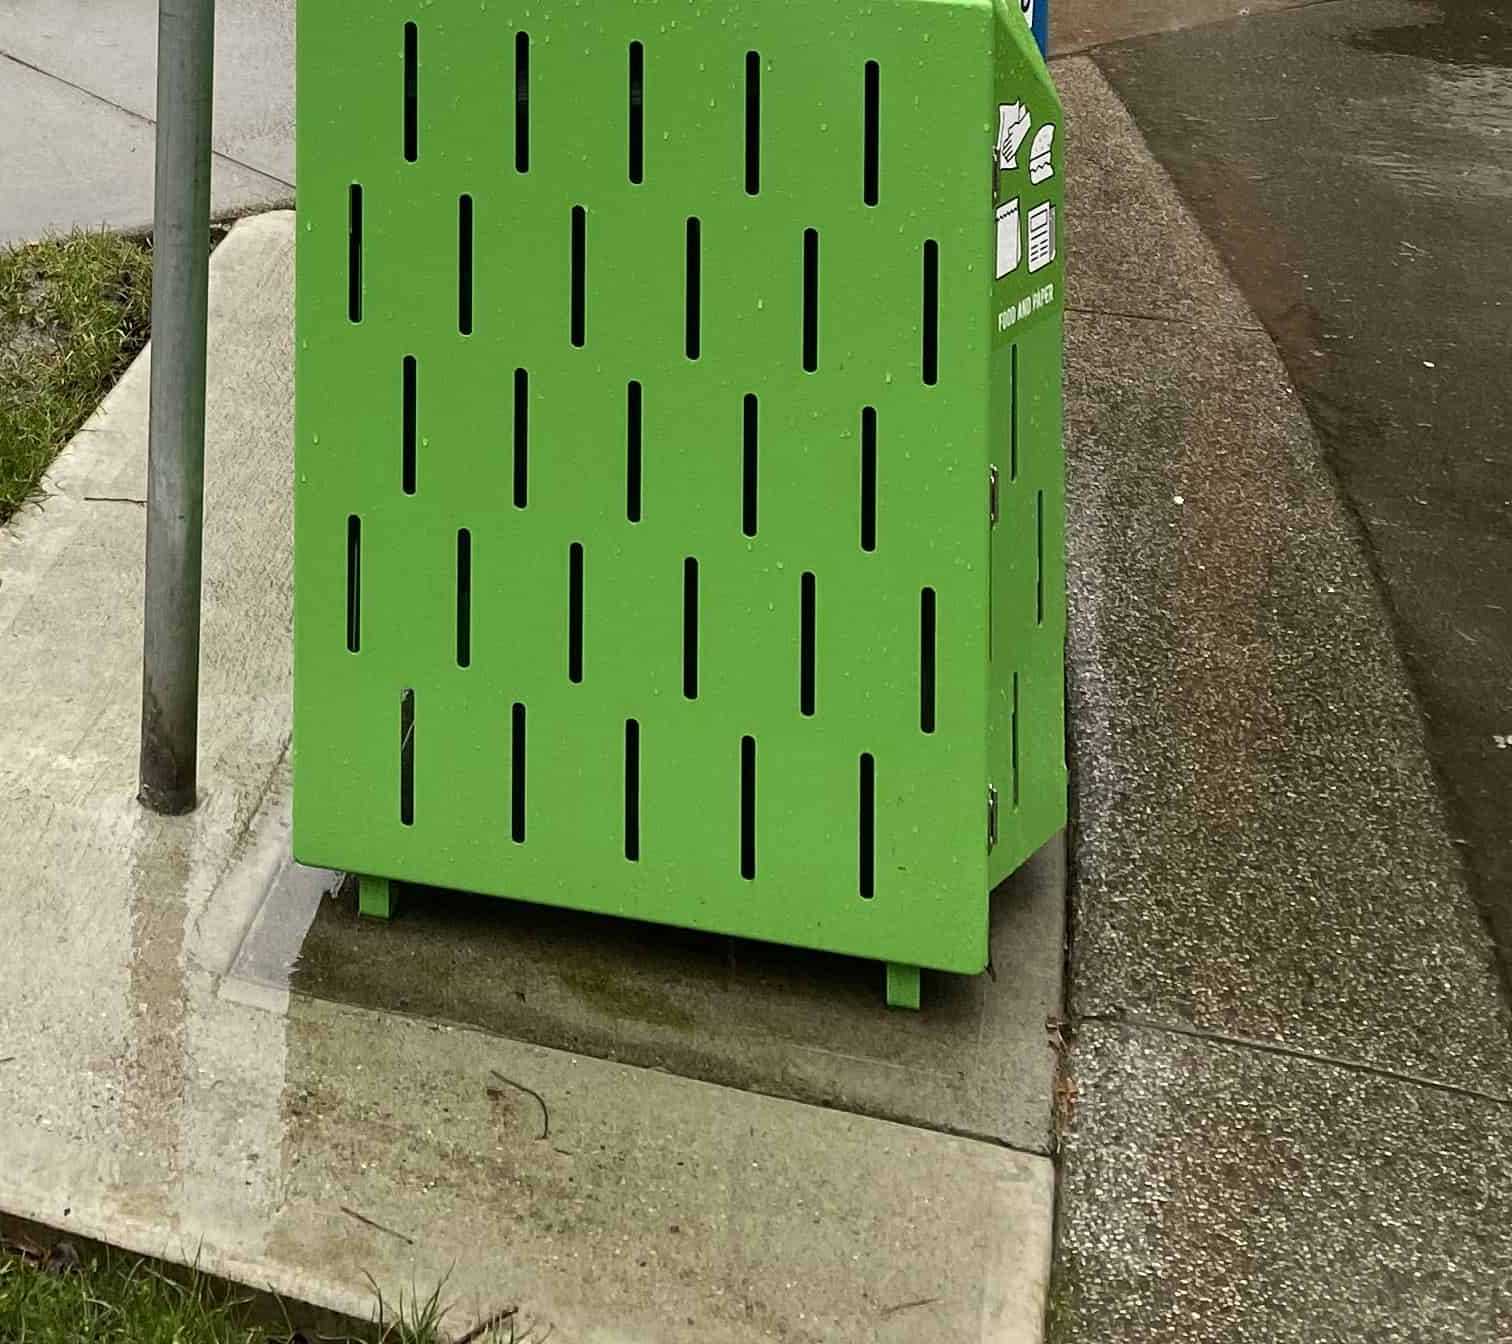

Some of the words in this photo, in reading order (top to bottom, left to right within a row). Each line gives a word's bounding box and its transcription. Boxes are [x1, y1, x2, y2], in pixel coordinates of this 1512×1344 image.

[998, 305, 1017, 332] FOOD
[1017, 296, 1032, 321] AND
[1032, 283, 1054, 312] PAPER
